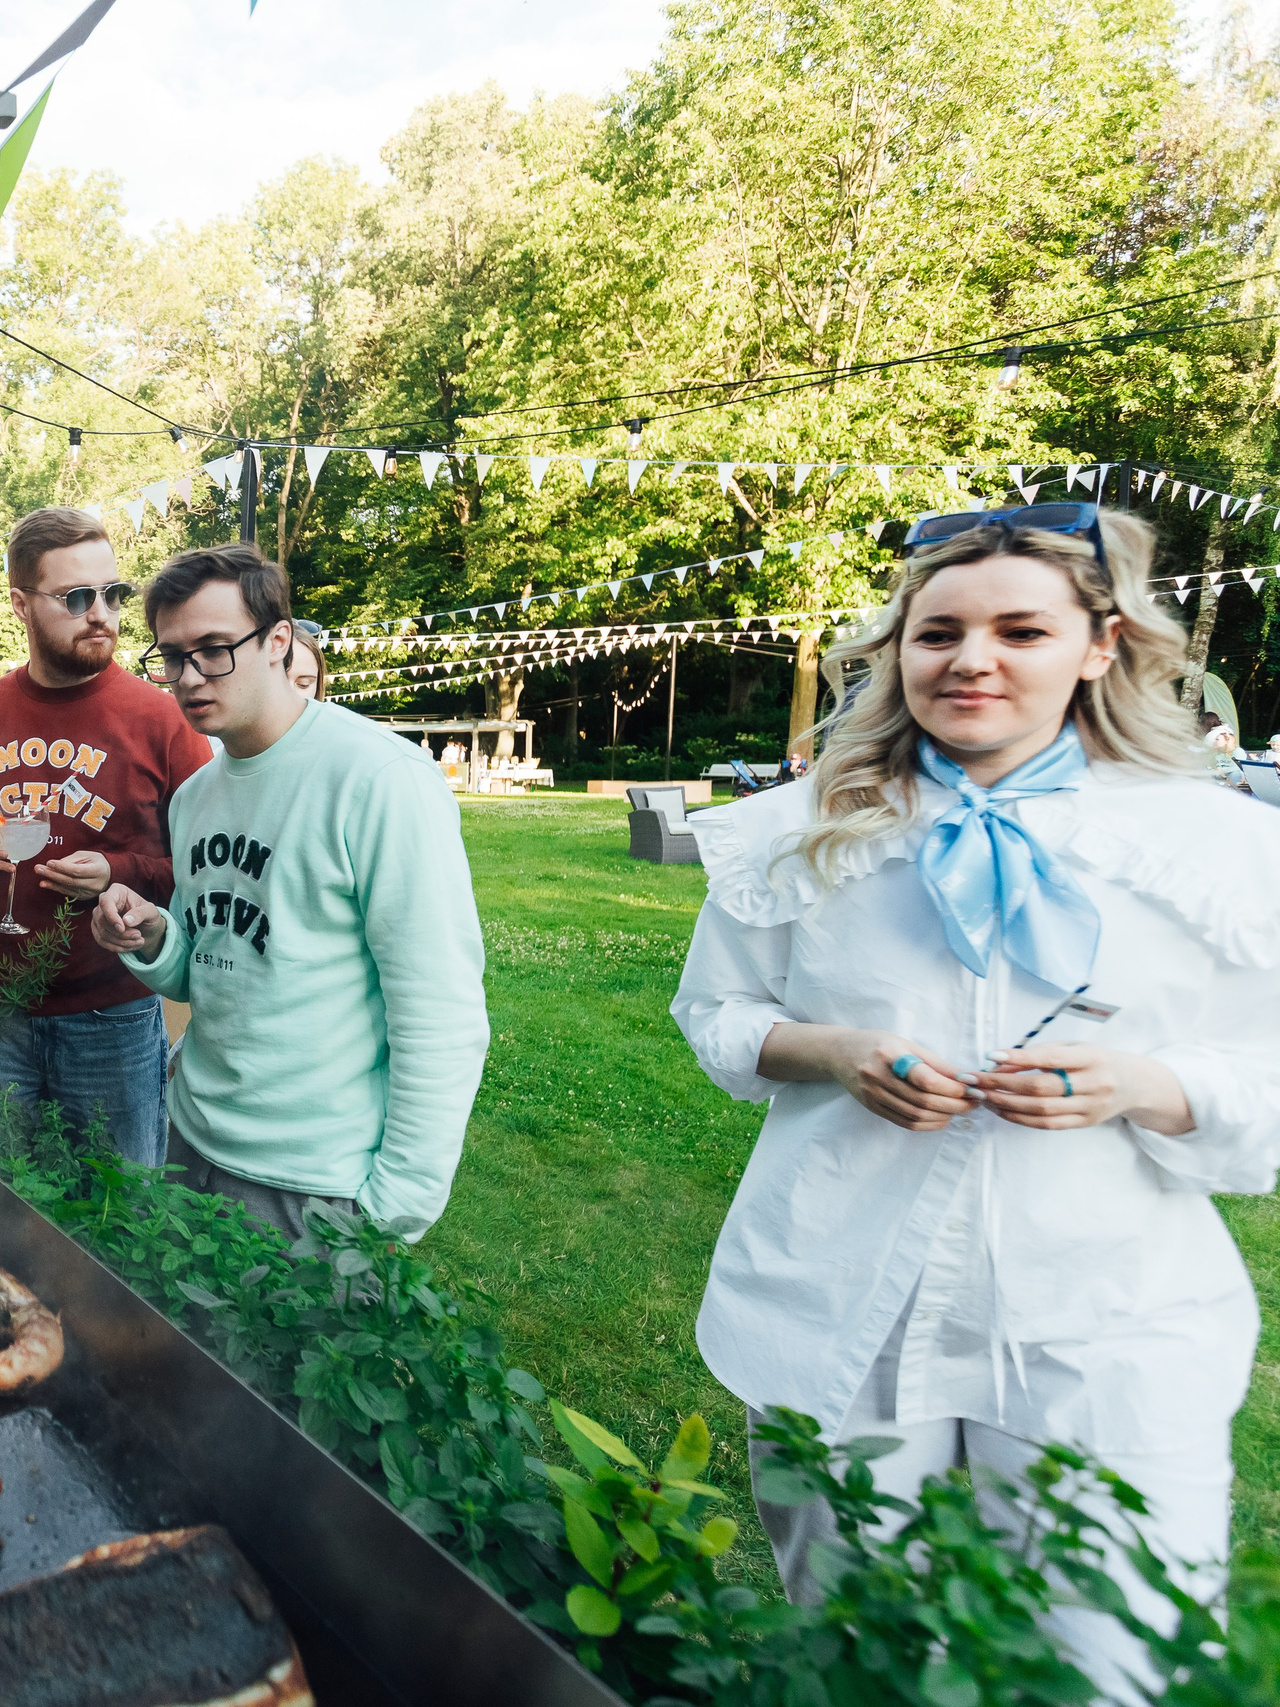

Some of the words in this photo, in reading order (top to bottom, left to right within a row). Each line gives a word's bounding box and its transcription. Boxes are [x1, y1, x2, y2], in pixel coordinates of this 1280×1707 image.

[47, 835, 63, 845] 011
[190, 831, 273, 882] MOON
[184, 889, 270, 957] CTVE
